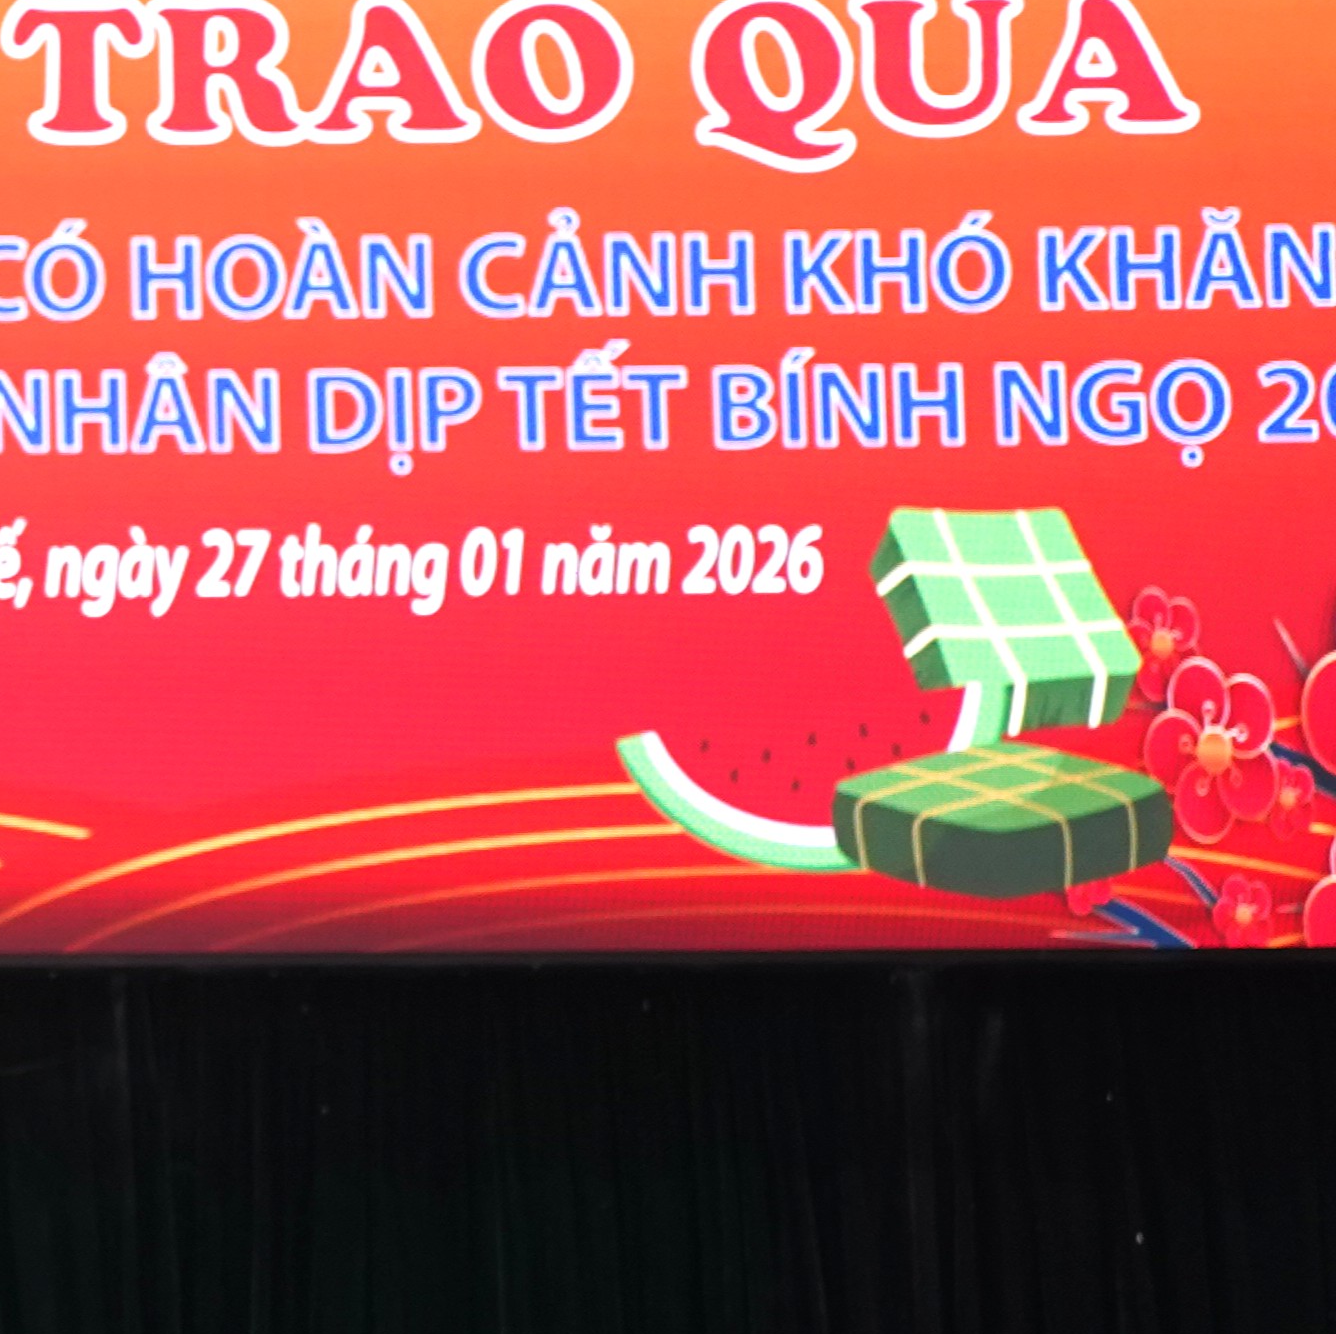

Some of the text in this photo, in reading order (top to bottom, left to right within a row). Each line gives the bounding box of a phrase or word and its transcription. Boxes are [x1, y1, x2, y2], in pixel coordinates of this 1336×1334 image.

[128, 216, 434, 321] HOÀN
[457, 205, 758, 320] CẢNH
[783, 209, 1014, 314] KHÓ
[1037, 205, 1336, 311] KHĂN
[306, 363, 482, 477] DỊP
[496, 337, 688, 451] TẾT
[710, 345, 965, 451] BÍNH
[993, 356, 1234, 469] NGỌ
[43, 524, 190, 619] ngày
[194, 526, 273, 599] 27
[277, 521, 451, 617] tháng
[458, 524, 526, 598] 01
[539, 523, 672, 597] năm
[680, 522, 826, 596] 2026
